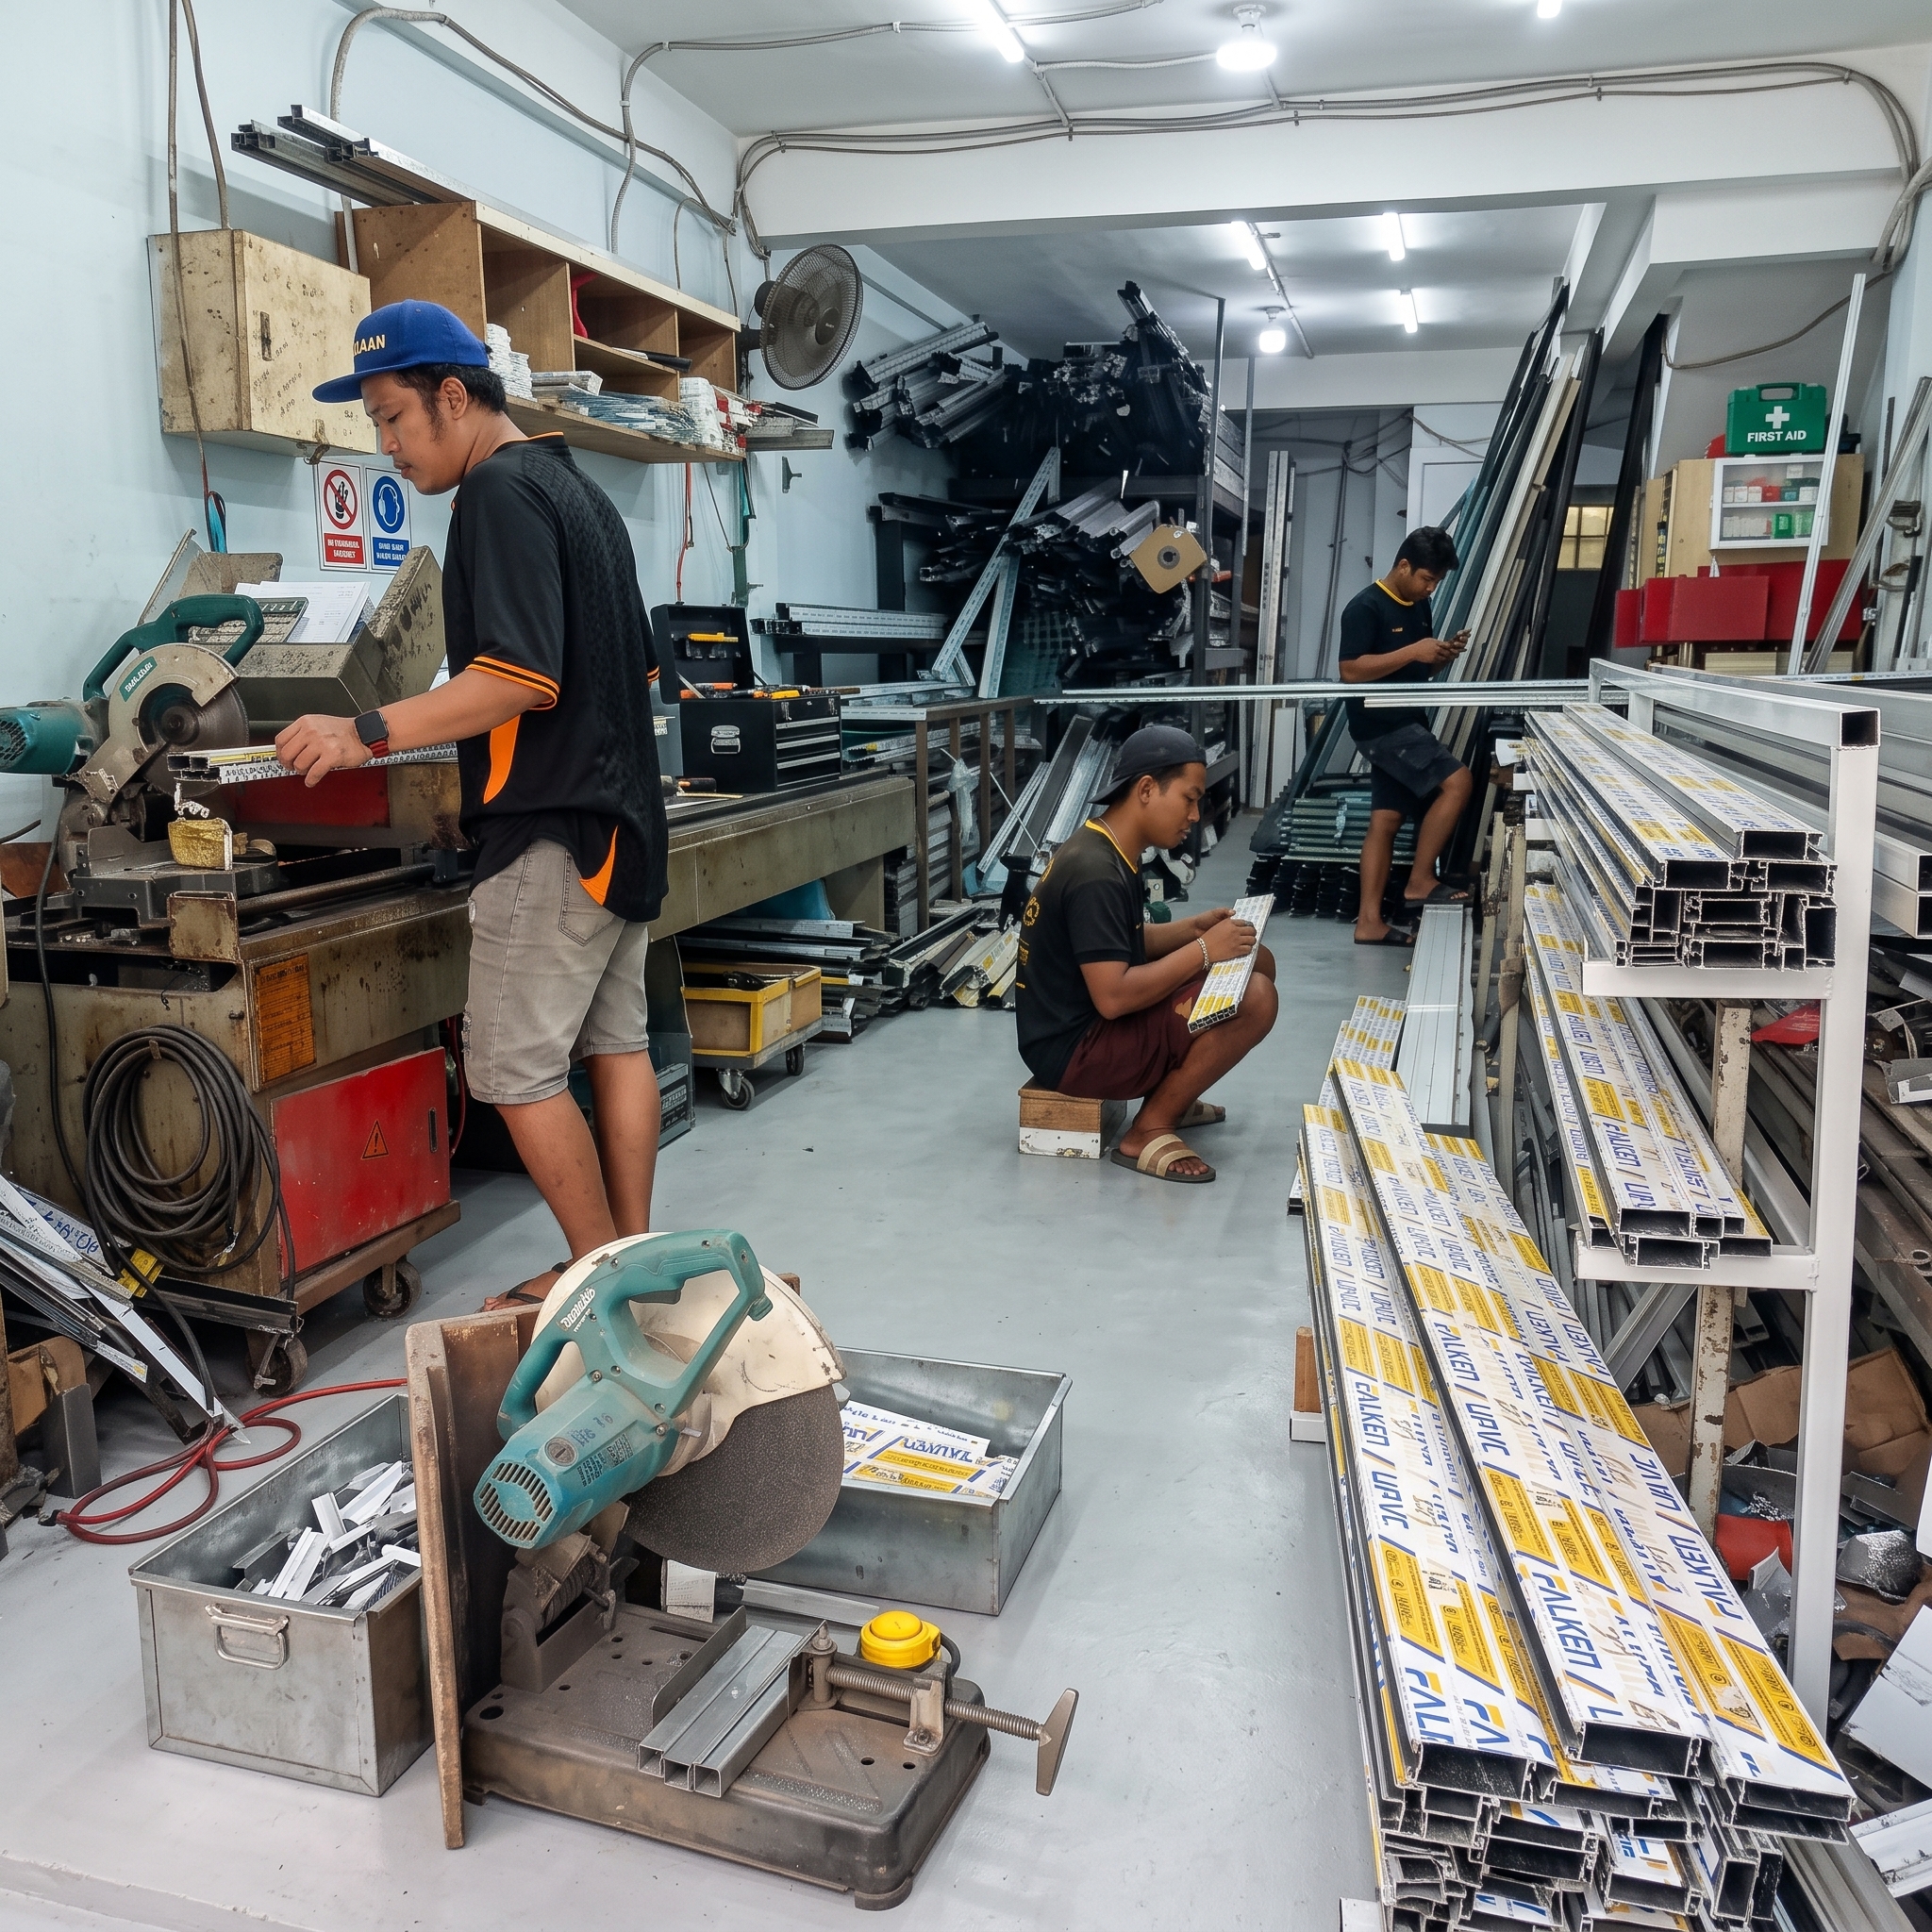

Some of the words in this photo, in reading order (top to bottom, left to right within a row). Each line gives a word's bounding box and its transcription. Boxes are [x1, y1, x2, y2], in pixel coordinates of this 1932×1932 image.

[1747, 431, 1783, 442] FIRST
[1785, 430, 1807, 441] AID
[1434, 1323, 1480, 1382] FALKEN
[1356, 1382, 1390, 1446] FALKEN
[1667, 1533, 1743, 1620] FALKEN
[1532, 1573, 1602, 1669] FALKEN
